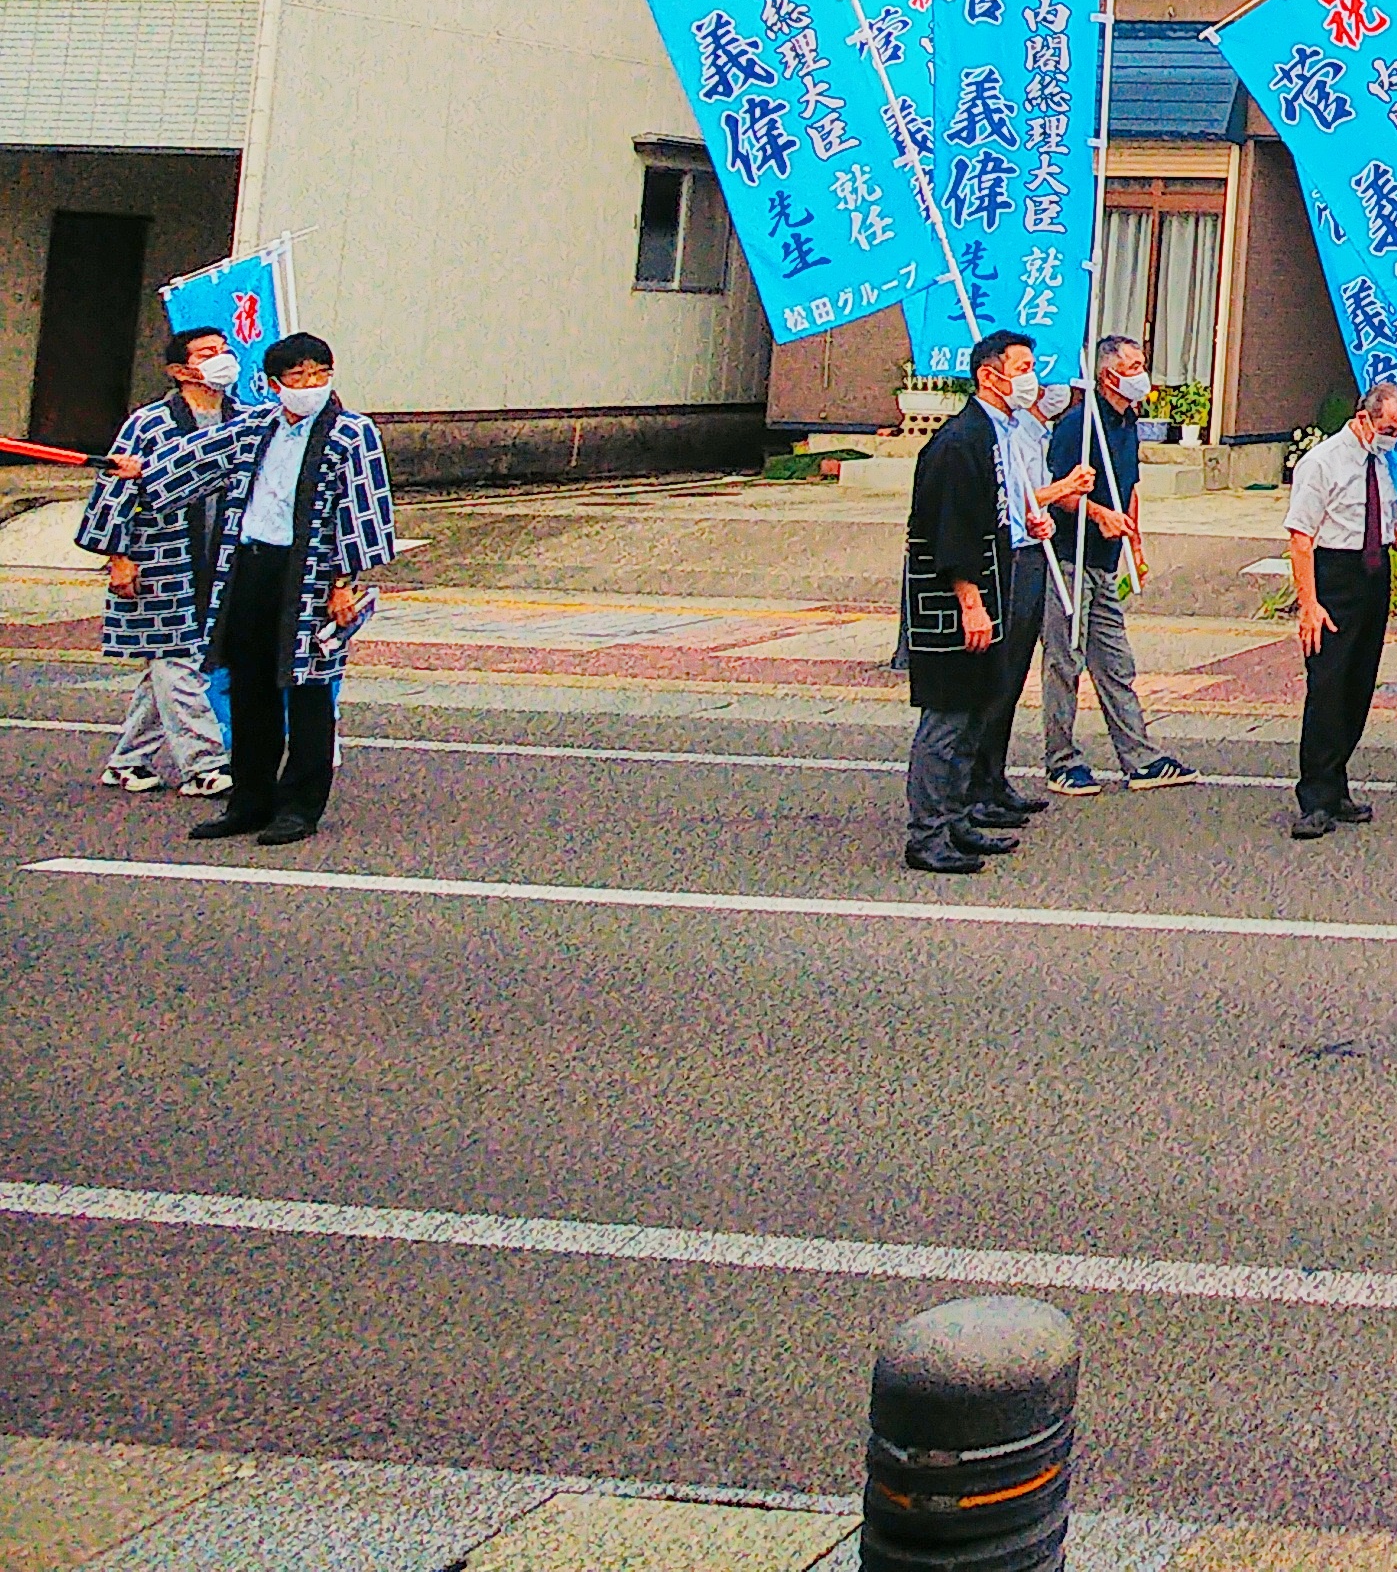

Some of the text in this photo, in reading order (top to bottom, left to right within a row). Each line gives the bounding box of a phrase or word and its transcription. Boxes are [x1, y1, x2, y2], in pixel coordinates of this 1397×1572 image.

[231, 291, 264, 348] 祝
[783, 263, 918, 334] 松田グループ
